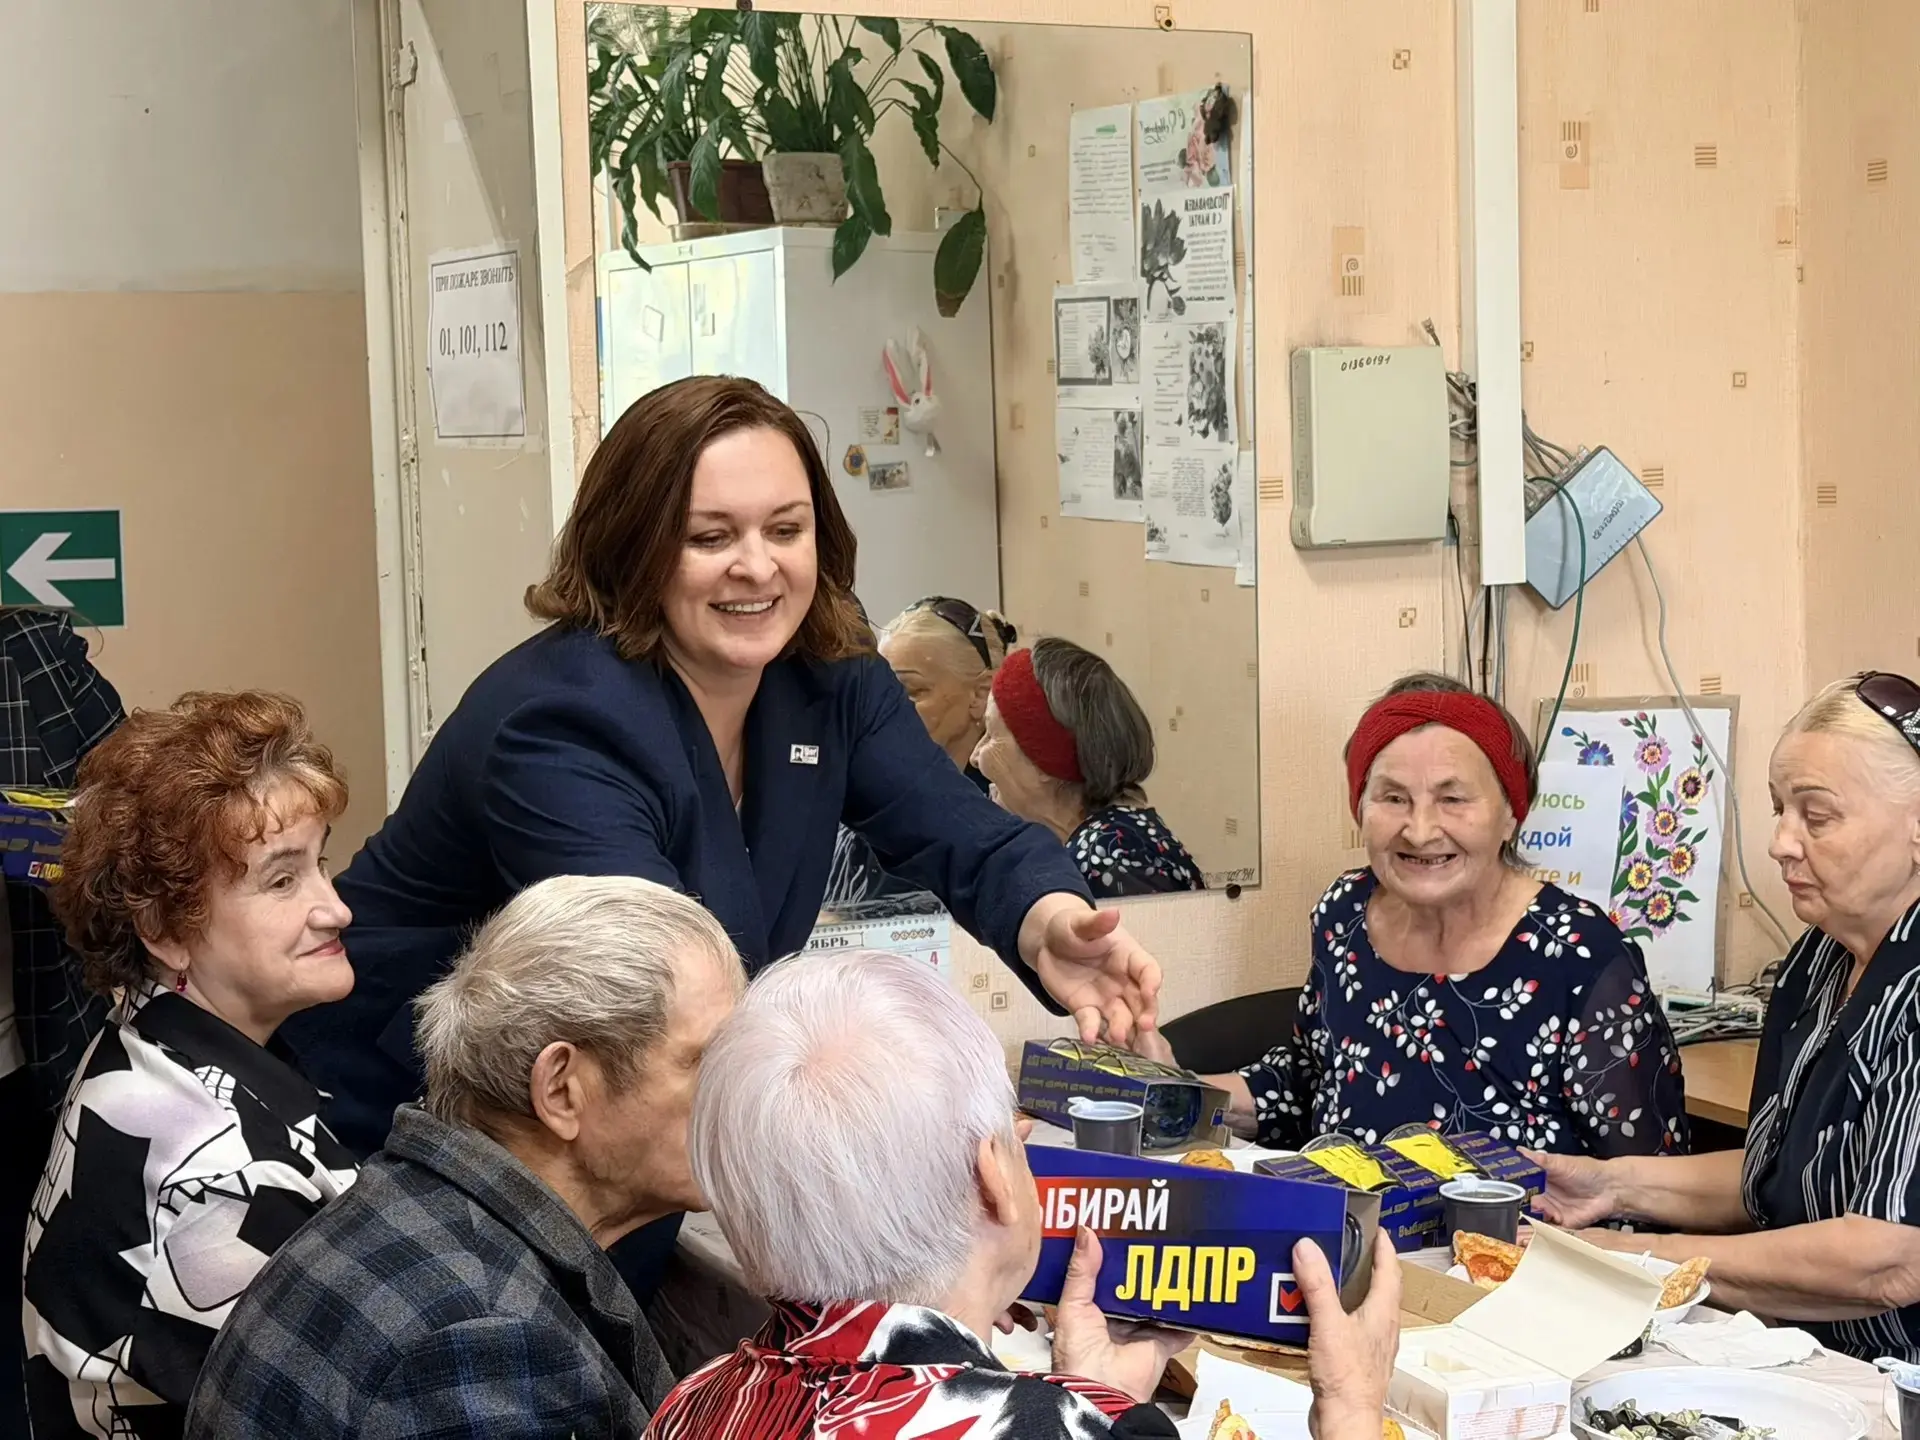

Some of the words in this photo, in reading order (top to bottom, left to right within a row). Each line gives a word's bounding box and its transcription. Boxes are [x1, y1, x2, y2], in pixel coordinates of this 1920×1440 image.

[435, 274, 450, 292] ПРИ
[450, 271, 480, 290] ПОЖАРЕ
[480, 266, 514, 286] ЗВОНИТЬ
[439, 328, 456, 360] 01,
[459, 325, 481, 358] 101,
[485, 321, 508, 352] 112
[1567, 871, 1582, 886] и
[807, 936, 849, 950] ЯБРЬ
[929, 951, 939, 966] 4
[1038, 1179, 1170, 1231] ЫБИРАЙ
[1115, 1245, 1256, 1311] ЛДПР
